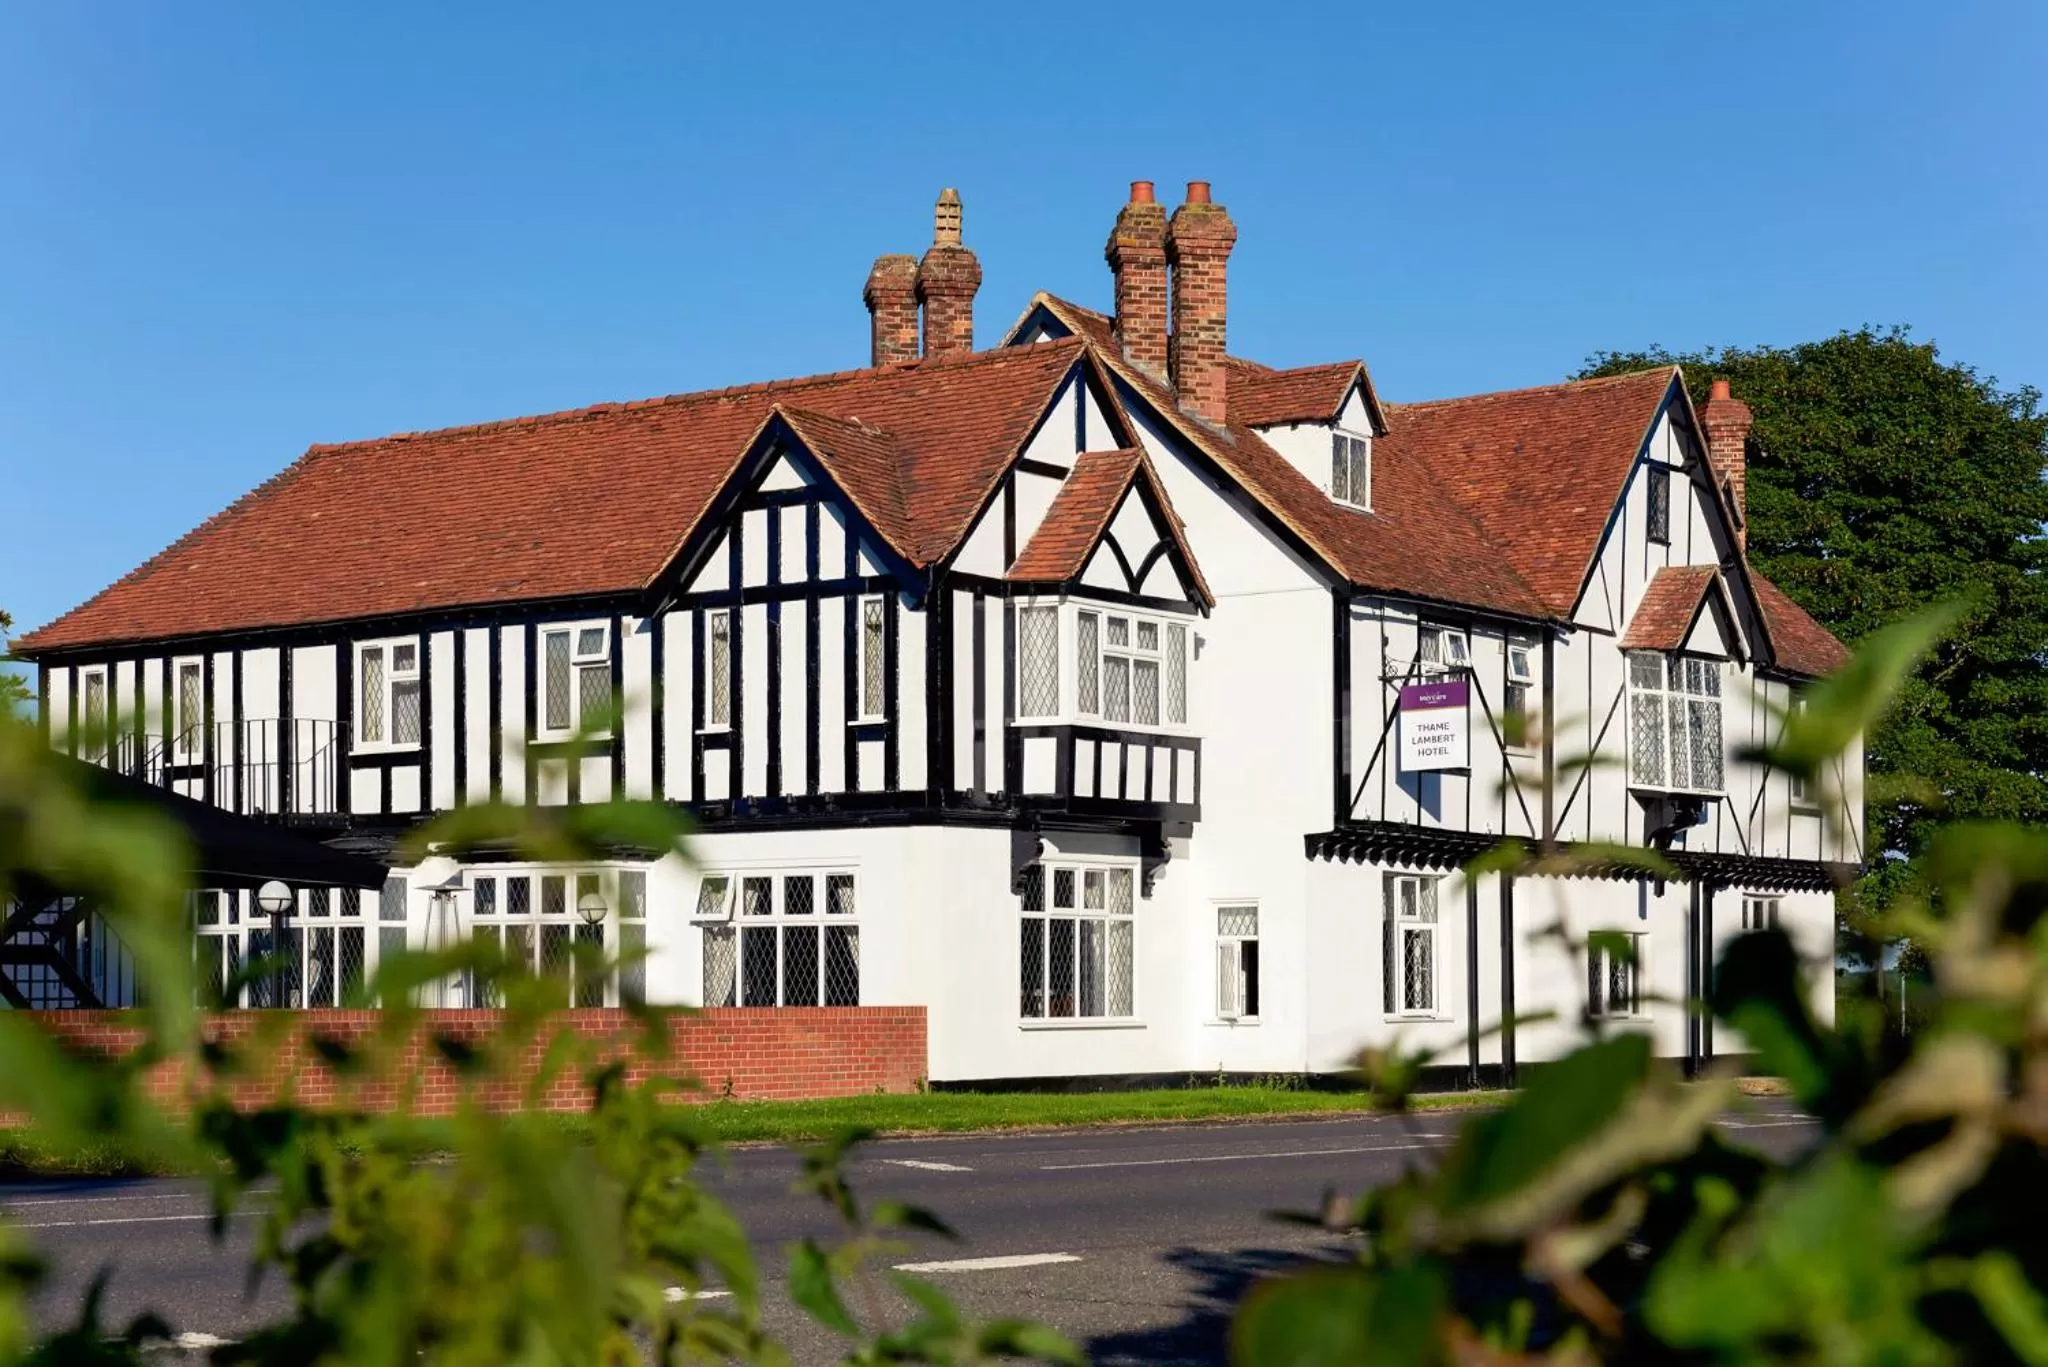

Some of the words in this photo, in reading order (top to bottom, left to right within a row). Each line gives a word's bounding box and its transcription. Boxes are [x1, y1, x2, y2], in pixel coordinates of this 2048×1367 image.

[1417, 722, 1450, 731] THAME
[1411, 734, 1455, 745] LAMBERT
[1418, 747, 1449, 756] HOTEL
